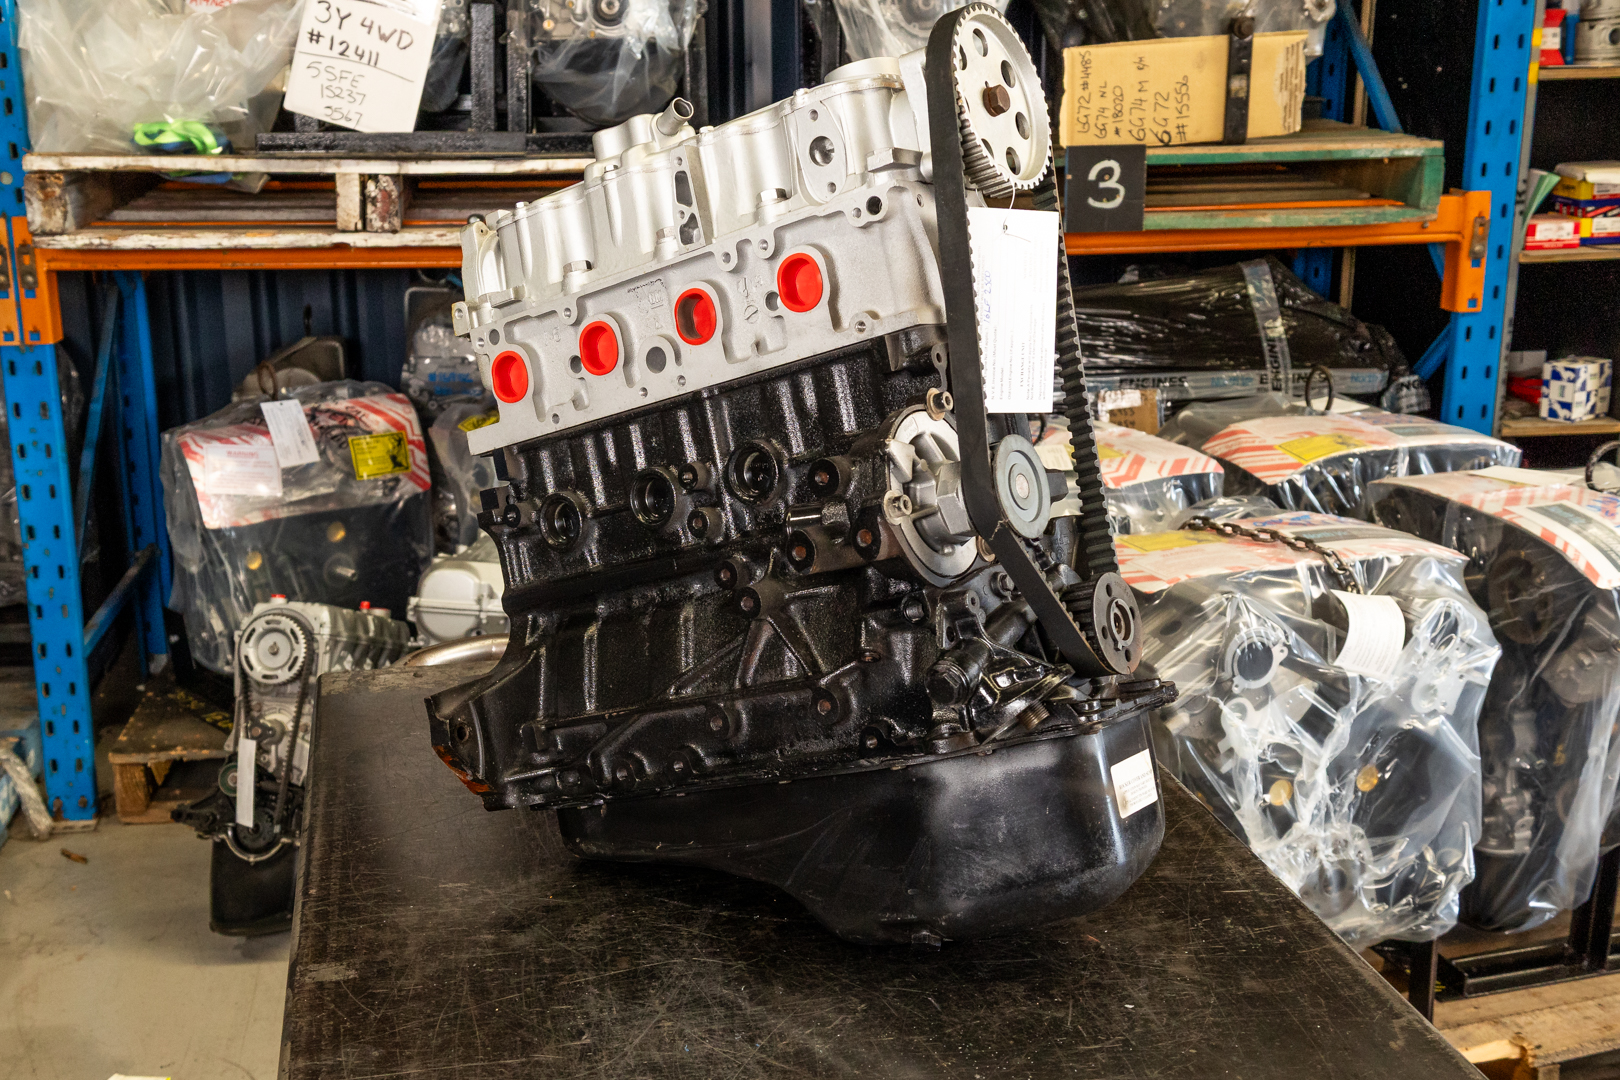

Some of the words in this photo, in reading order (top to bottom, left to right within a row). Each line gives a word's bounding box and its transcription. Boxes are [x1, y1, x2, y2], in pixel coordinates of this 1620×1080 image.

[307, 28, 379, 66] #12411
[315, 1, 352, 29] 3Y
[360, 17, 413, 49] 4WD
[1099, 81, 1107, 98] NL
[1112, 85, 1124, 137] #18020
[1129, 99, 1147, 141] 6G74
[1138, 80, 1149, 93] M
[1175, 75, 1189, 142] #15556
[1094, 107, 1109, 138] 6G74
[1149, 91, 1171, 145] 6G72
[1088, 159, 1125, 208] 3
[1118, 375, 1188, 389] ENGINES
